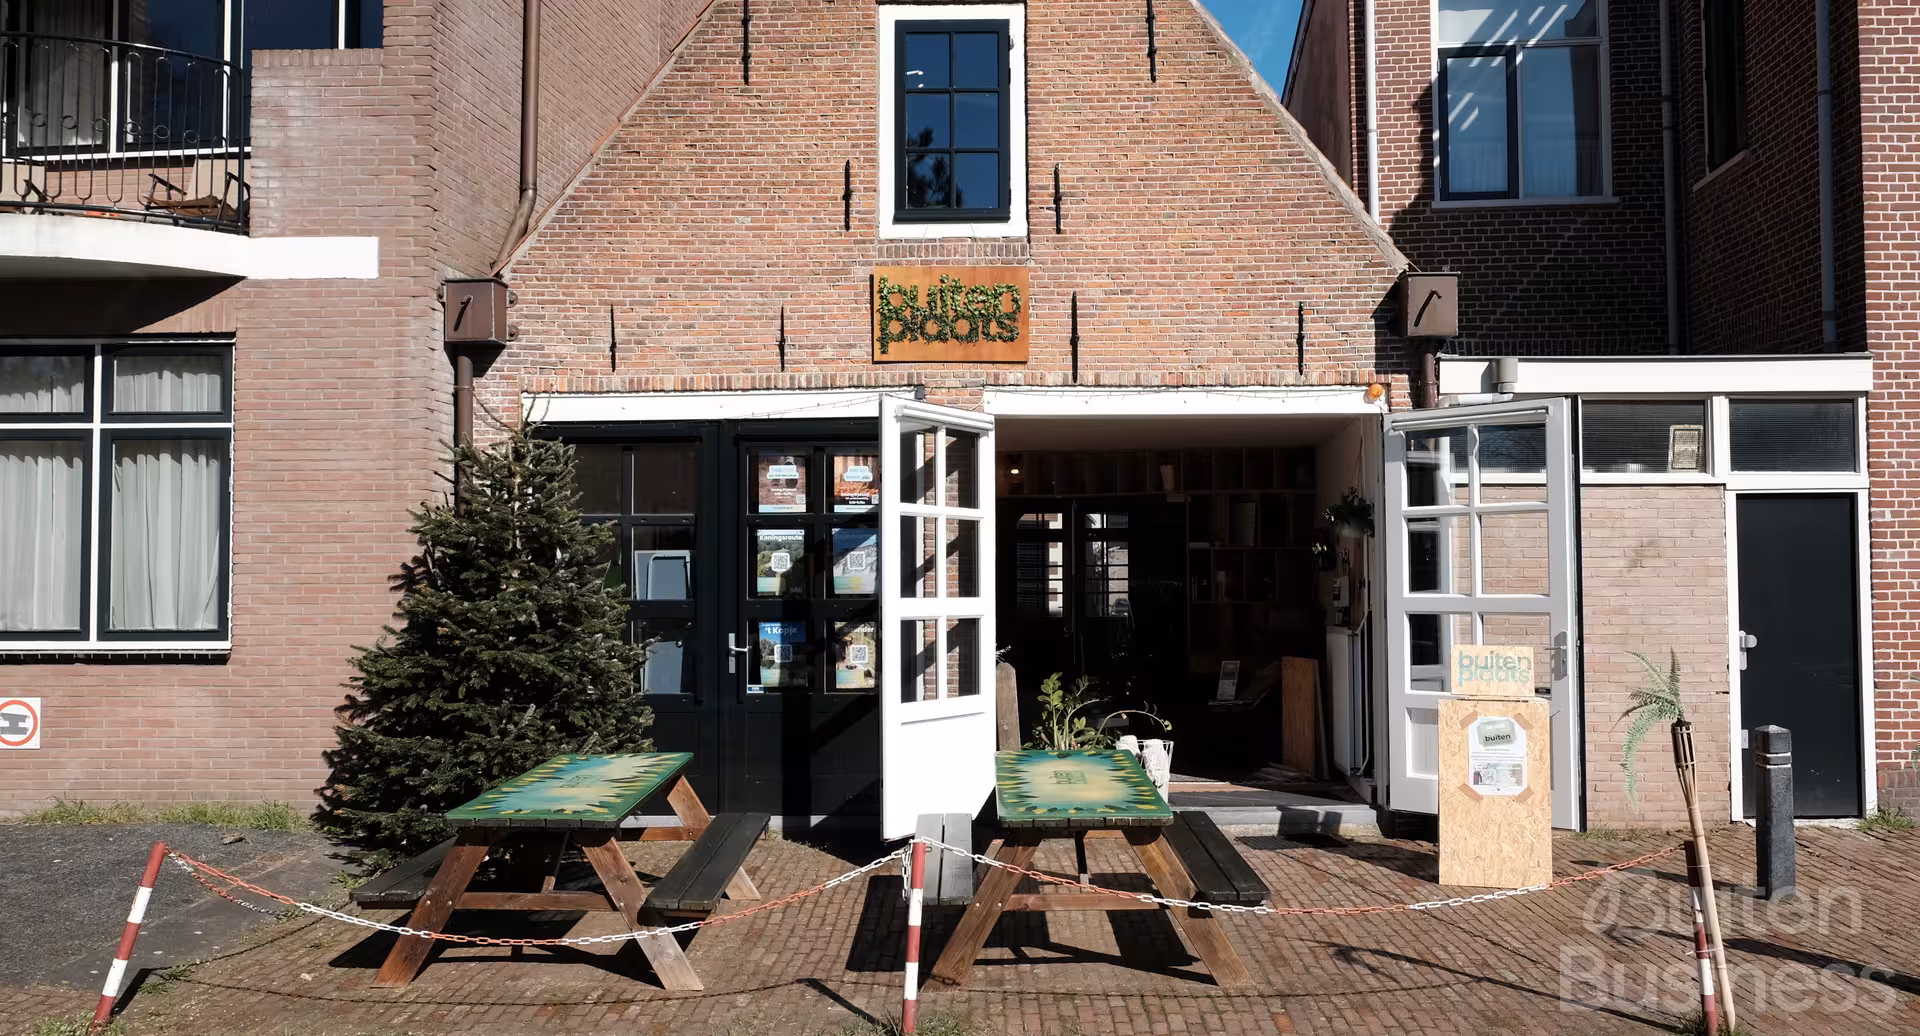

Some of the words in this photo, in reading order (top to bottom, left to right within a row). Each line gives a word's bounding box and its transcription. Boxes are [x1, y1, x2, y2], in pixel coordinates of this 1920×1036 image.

[877, 274, 1021, 317] buiten
[760, 534, 802, 542] Koningsroute
[773, 627, 798, 636] Kopje
[1458, 650, 1532, 671] buiten
[1484, 733, 1511, 742] buiten
